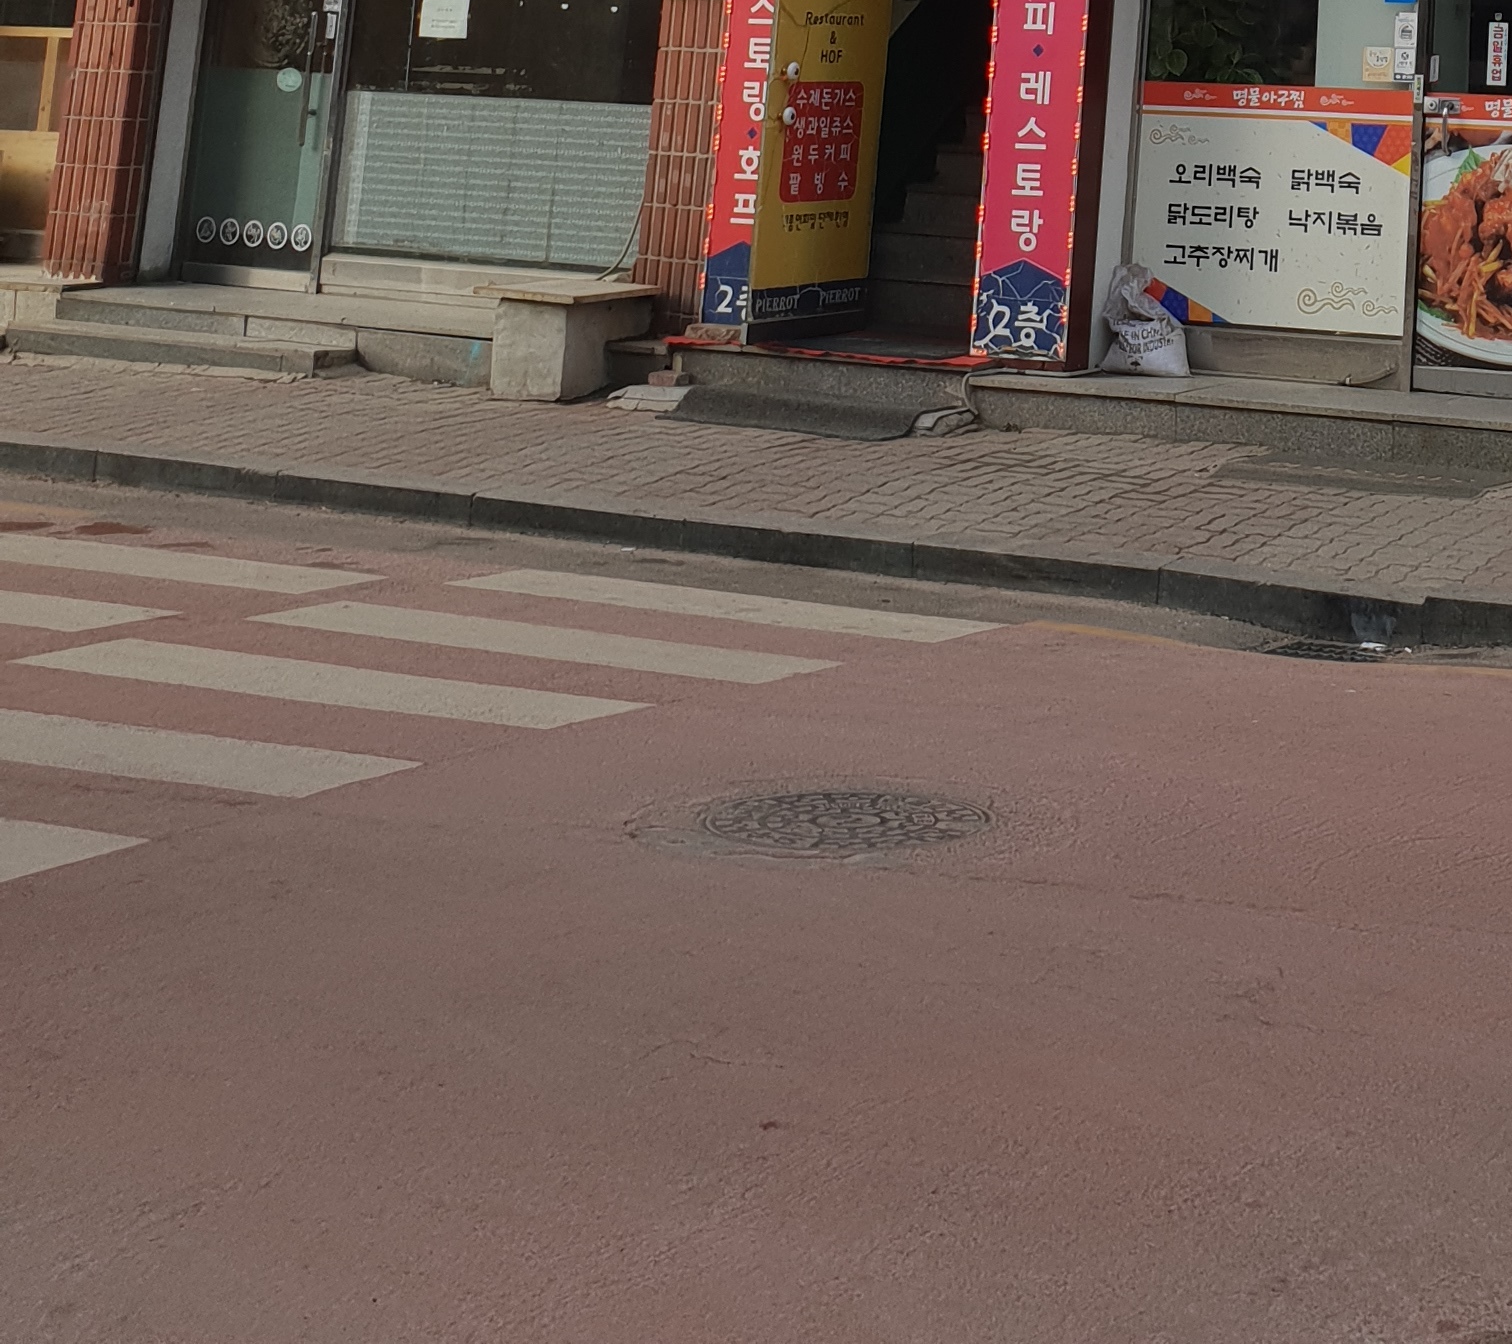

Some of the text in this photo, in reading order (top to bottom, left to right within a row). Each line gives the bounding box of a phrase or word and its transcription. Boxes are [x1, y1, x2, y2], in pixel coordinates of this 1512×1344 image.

[805, 11, 865, 27] Restaurant
[829, 30, 838, 45] &
[821, 50, 843, 64] HOF
[796, 88, 856, 110] 수제돈가스
[794, 115, 853, 138] 생과일쥬스
[1169, 161, 1361, 196] 오리백숙 닭백숙
[1167, 203, 1384, 237] 닭도리탕 낙지볶음
[1163, 244, 1280, 273] 고추장찌개
[755, 286, 860, 314] PIERROT PIERROT
[989, 301, 1045, 348] 2층
